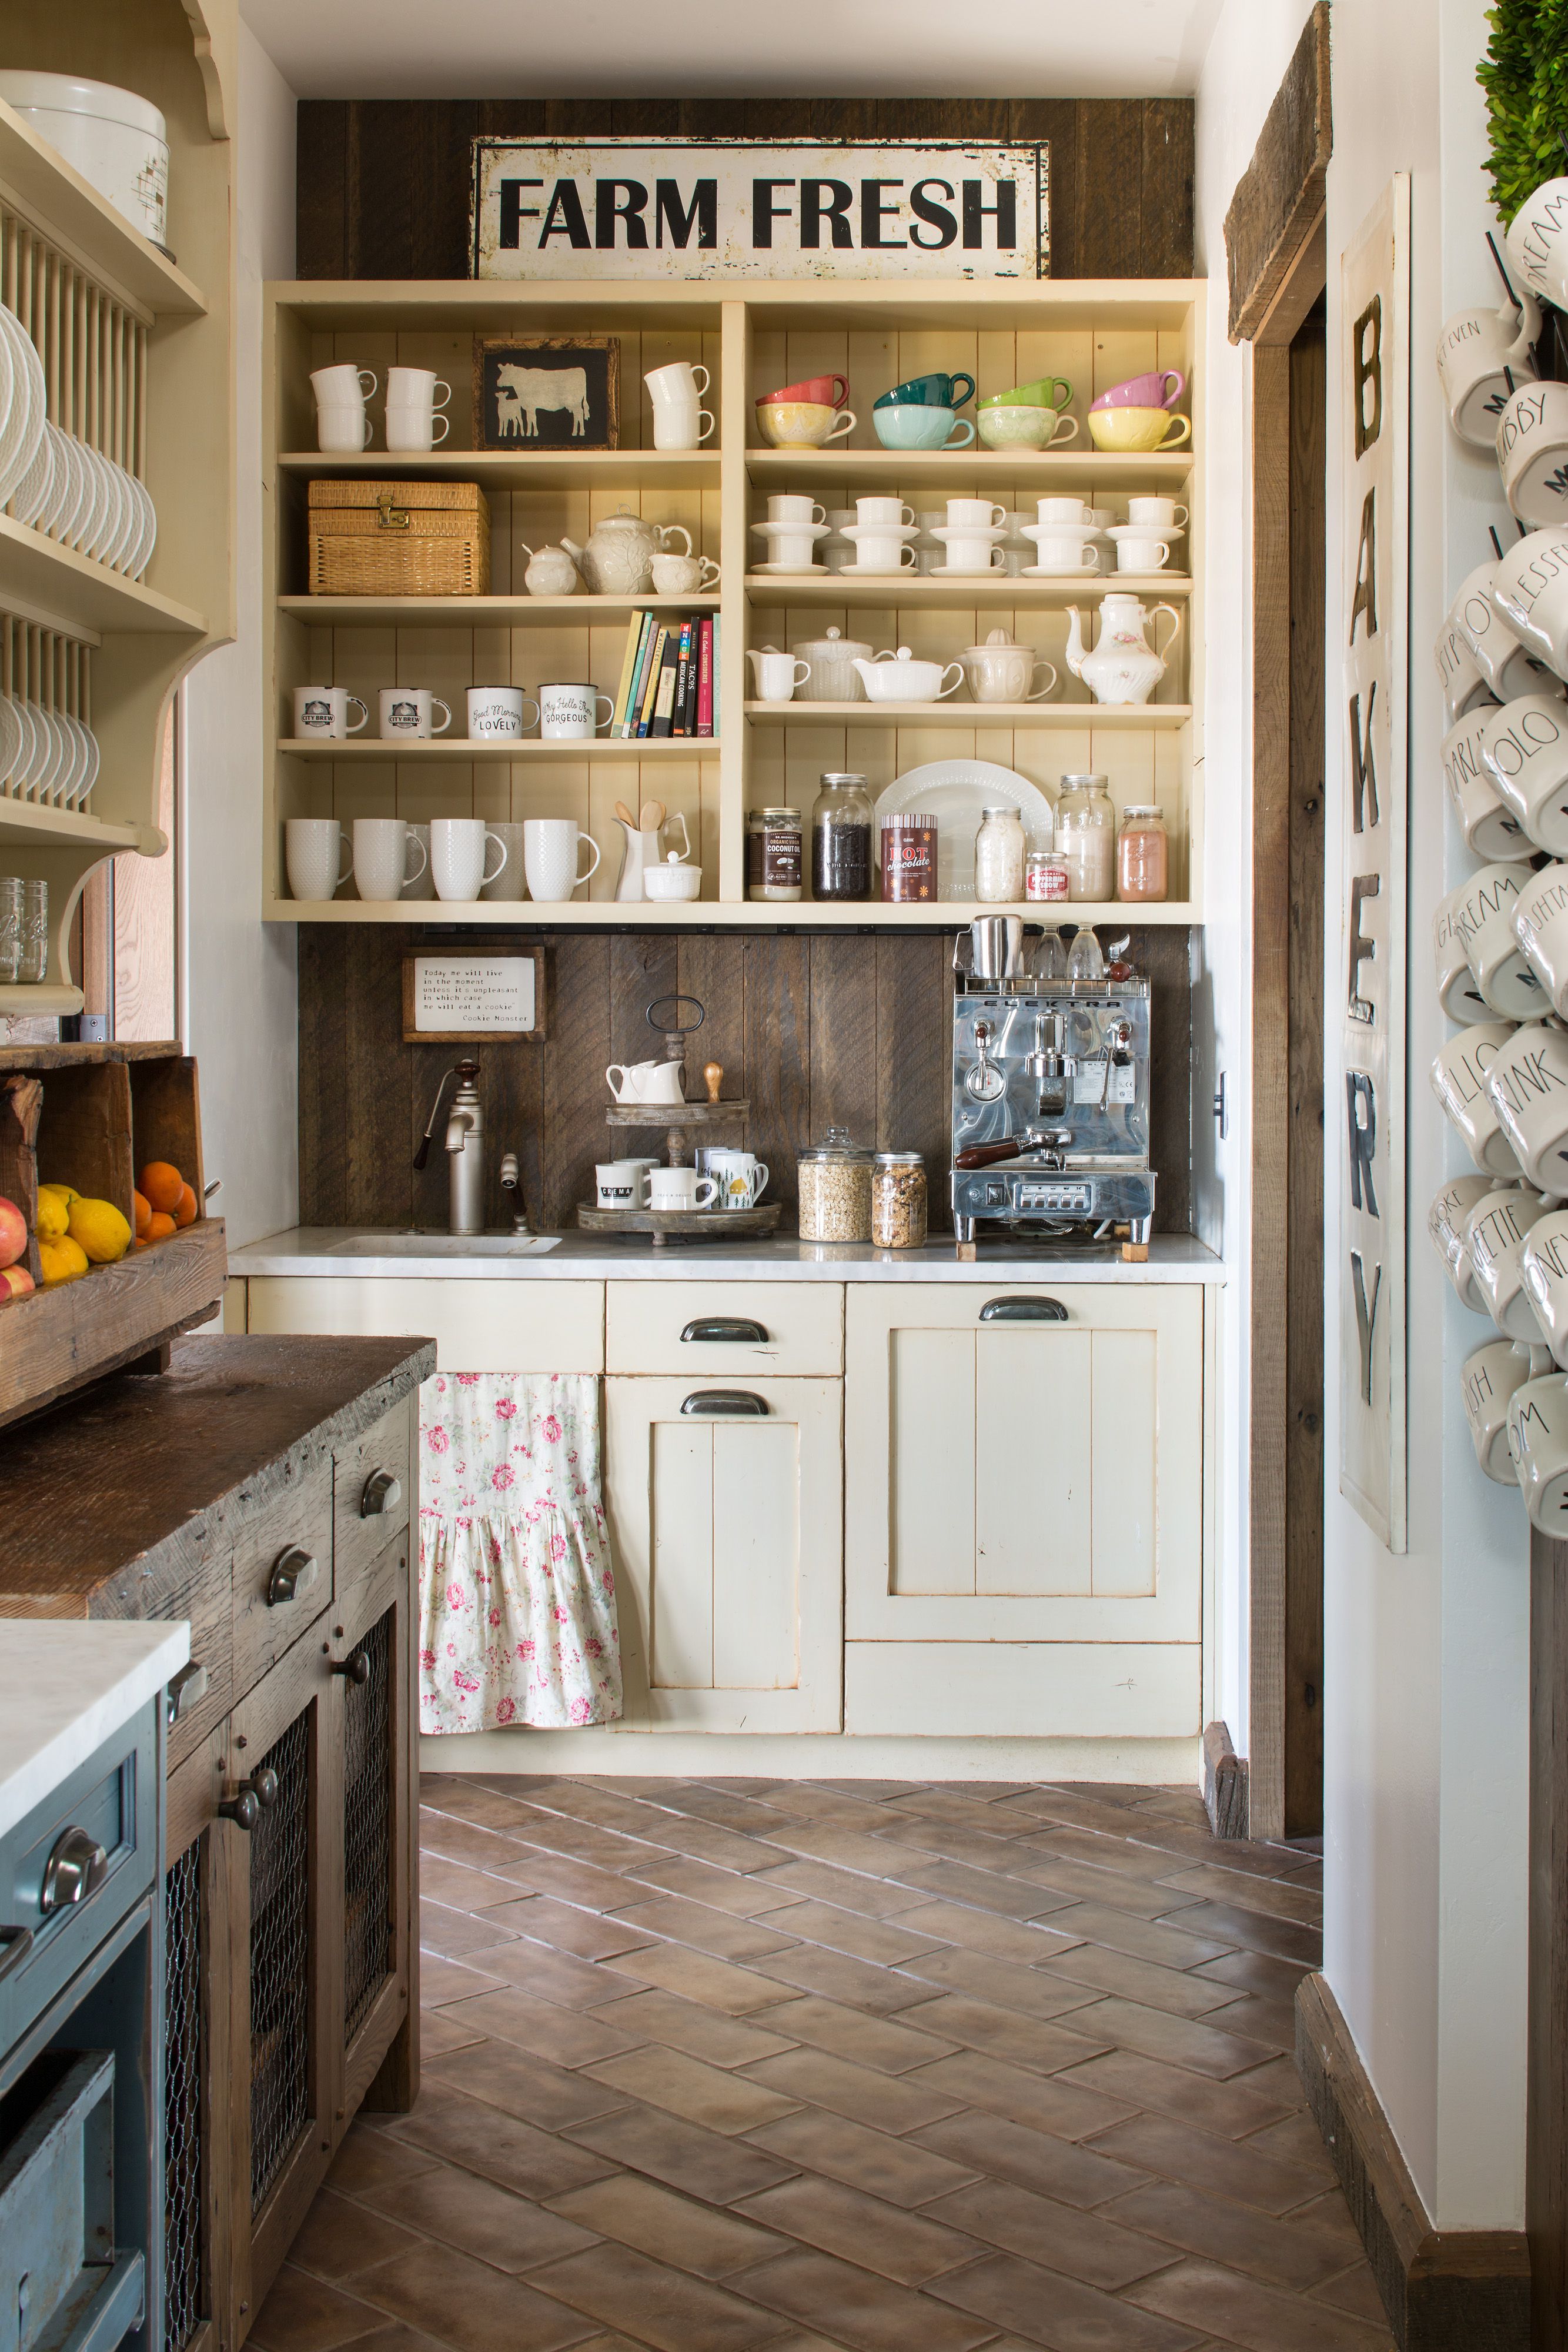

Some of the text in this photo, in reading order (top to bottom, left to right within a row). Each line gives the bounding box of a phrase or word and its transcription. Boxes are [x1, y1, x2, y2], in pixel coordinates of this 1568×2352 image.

[499, 178, 1017, 249] FARM FRESH
[1448, 321, 1480, 349] EVEN
[1500, 393, 1546, 465] UBBY
[654, 633, 664, 662] WAFFLES
[680, 626, 689, 659] KNACK
[1440, 634, 1460, 687] SIP
[473, 706, 489, 726] Good
[557, 697, 577, 709] Hello
[480, 718, 516, 730] LOVELY
[546, 714, 587, 724] GORGEOUS
[1488, 712, 1559, 794] YOLO
[890, 847, 928, 861] HOT
[1346, 293, 1381, 1406] BAKERY
[887, 857, 931, 871] chocolate
[1455, 878, 1519, 954] DREAM
[701, 1167, 711, 1177] cof
